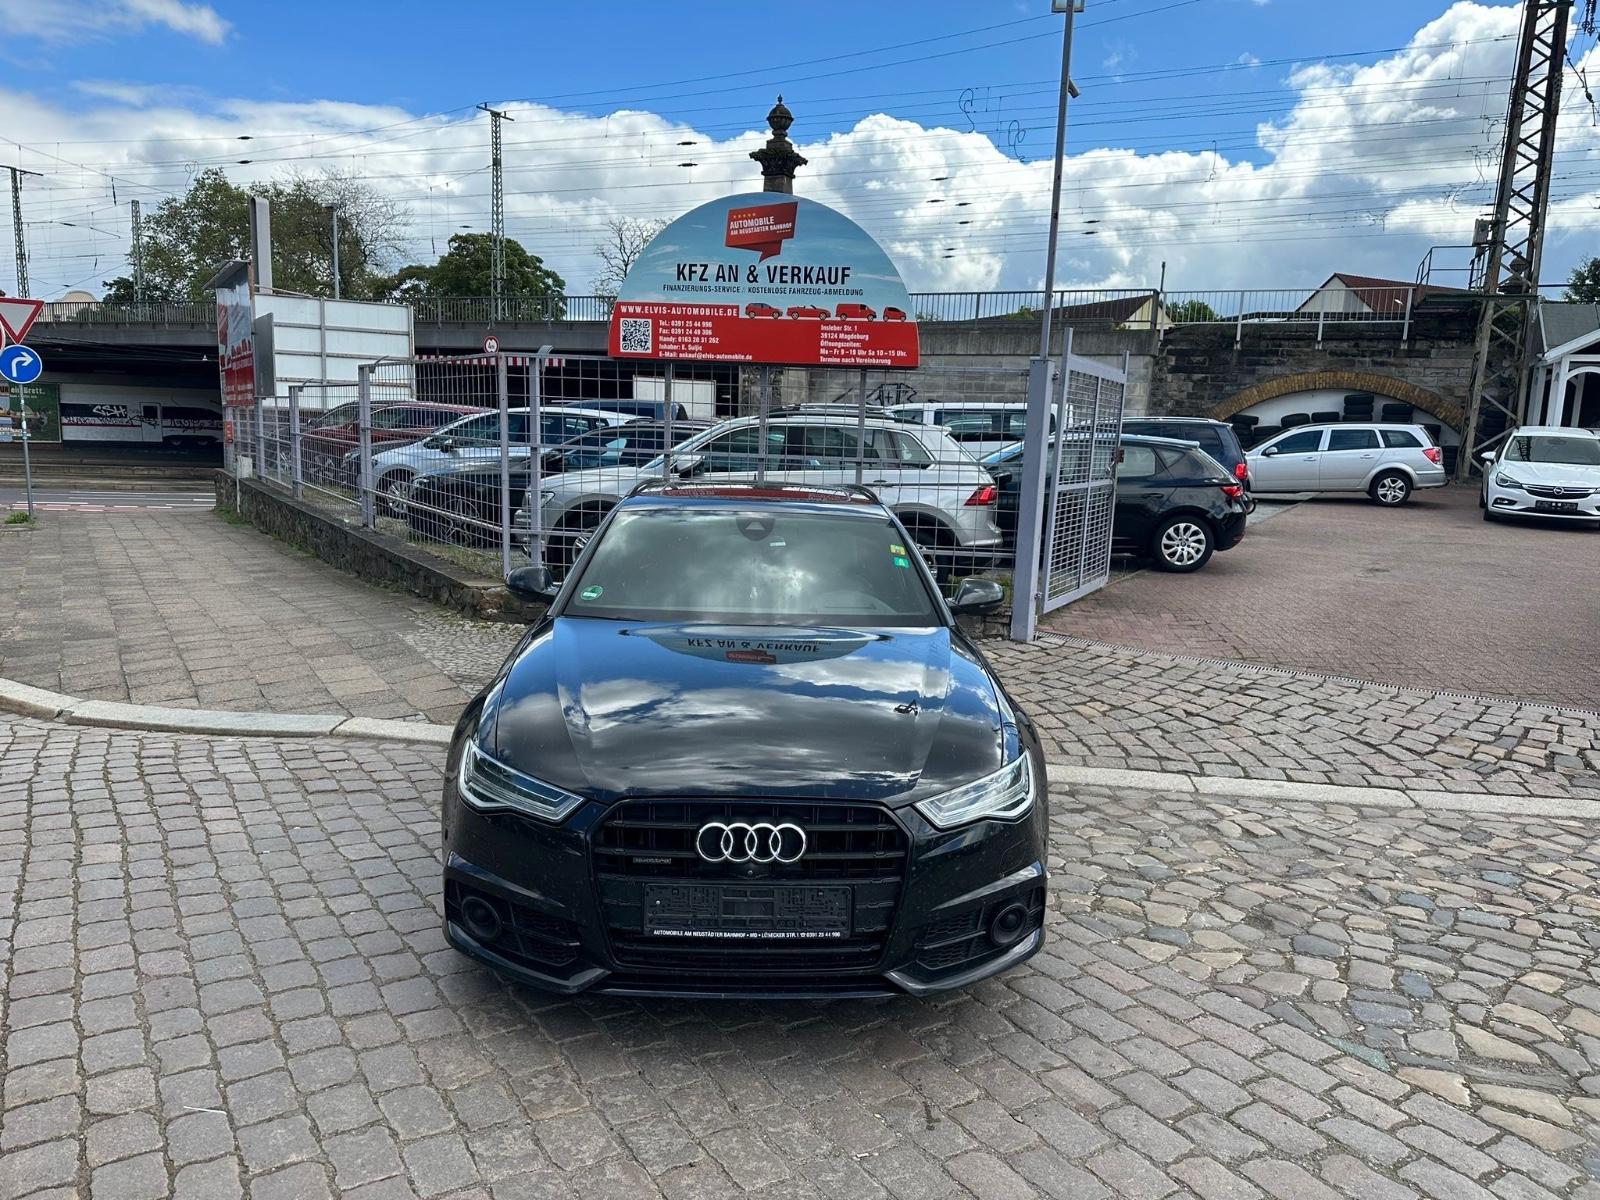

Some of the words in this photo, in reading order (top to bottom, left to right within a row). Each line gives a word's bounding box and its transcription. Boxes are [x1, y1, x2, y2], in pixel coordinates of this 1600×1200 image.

[730, 216, 774, 230] AUTOMOBILE
[770, 222, 792, 231] BAHNHOF
[676, 263, 708, 282] KFZ
[716, 264, 738, 282] AN
[746, 264, 758, 283] &
[766, 265, 851, 285] VERKAUF
[663, 284, 740, 293] FINANZIERUNGS-SERVICE
[788, 288, 864, 296] FAHRZEUG-ABMELDUNG
[620, 305, 738, 316] WWW.ELVIS-AUTOMOBILE.DE
[679, 352, 752, 360] ankauf@elvis-automobile.de
[856, 357, 891, 365] Vereinbarung
